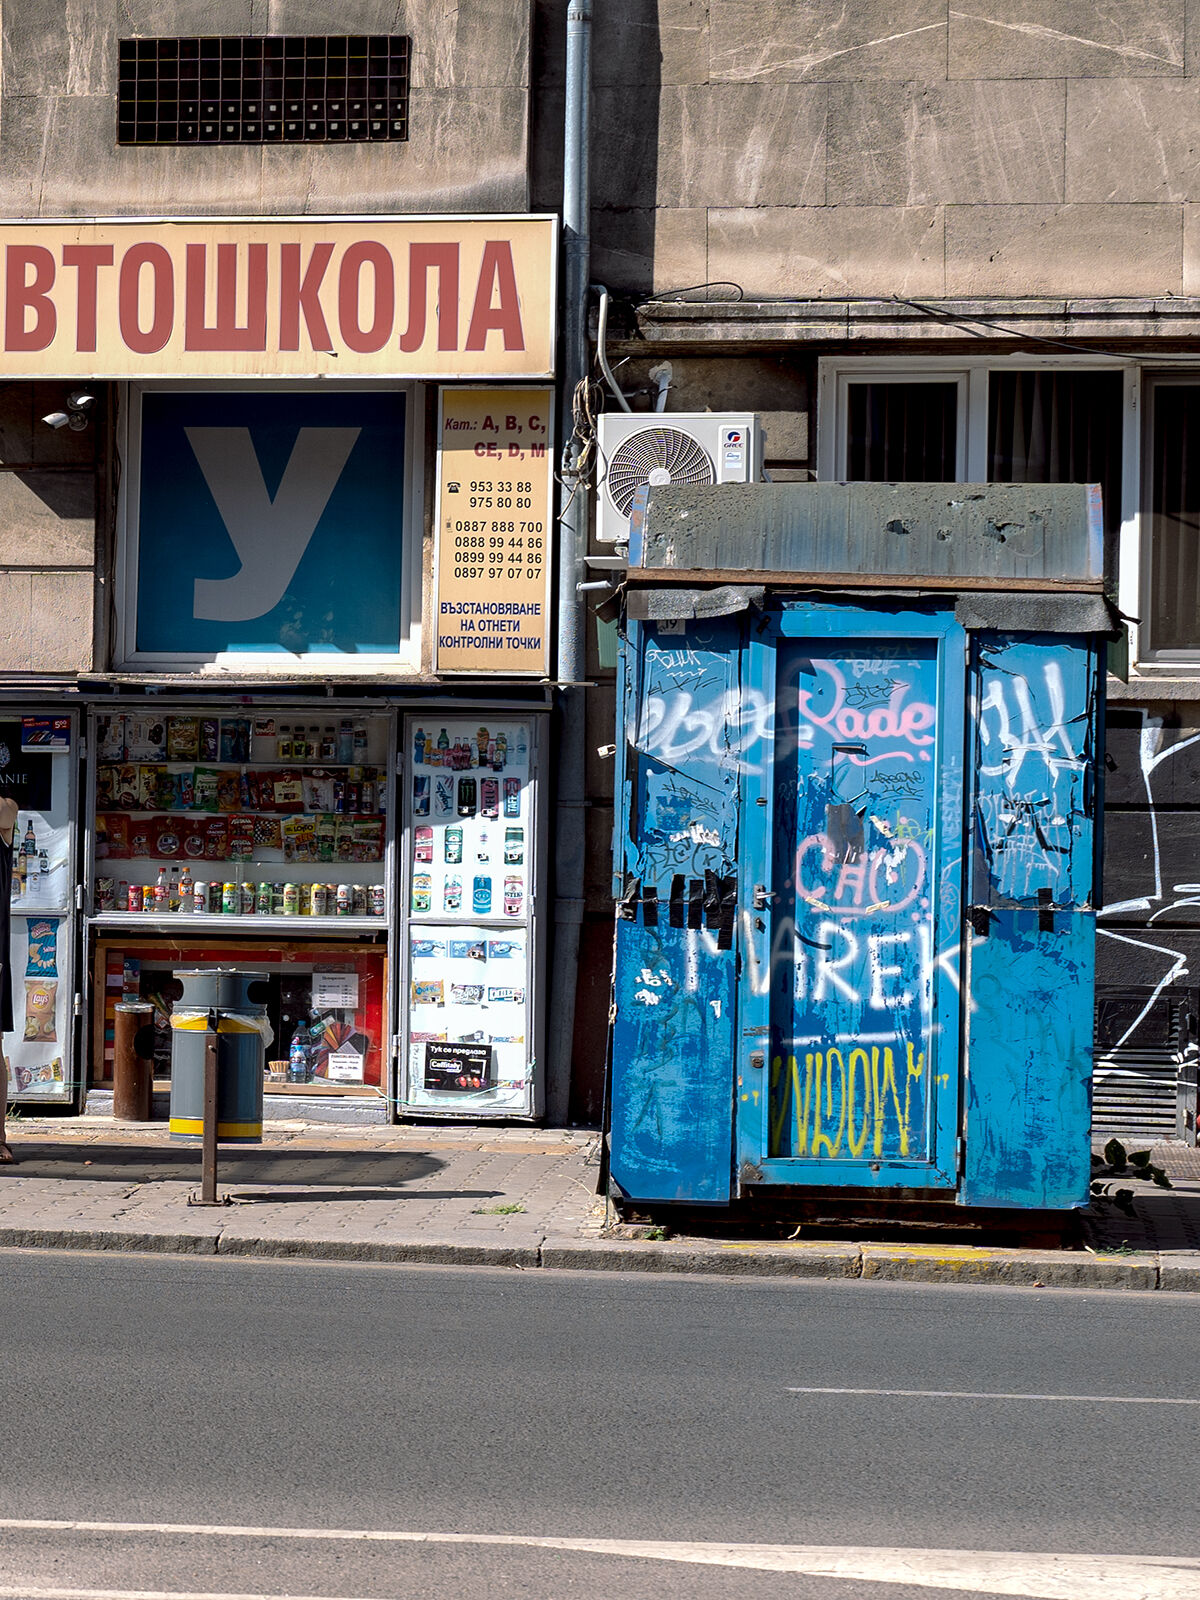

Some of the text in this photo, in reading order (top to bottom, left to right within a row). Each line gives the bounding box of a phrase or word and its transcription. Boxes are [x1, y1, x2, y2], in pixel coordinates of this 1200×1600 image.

[531, 442, 545, 457] M
[470, 481, 532, 493] 953 33 88
[469, 496, 532, 509] 975 80 80
[455, 520, 543, 533] 0887 888 700
[455, 536, 543, 549] 0888 99 44 86
[454, 551, 542, 564] 0899 99 44 86
[454, 567, 542, 579] 0897 97 07 07
[440, 601, 541, 616] ВЪЗСТАНОВЯВАНЕ
[460, 619, 520, 632] НА ОТНЕТИ
[439, 635, 541, 650] КОНТРОЛНИ ТОЧКИ
